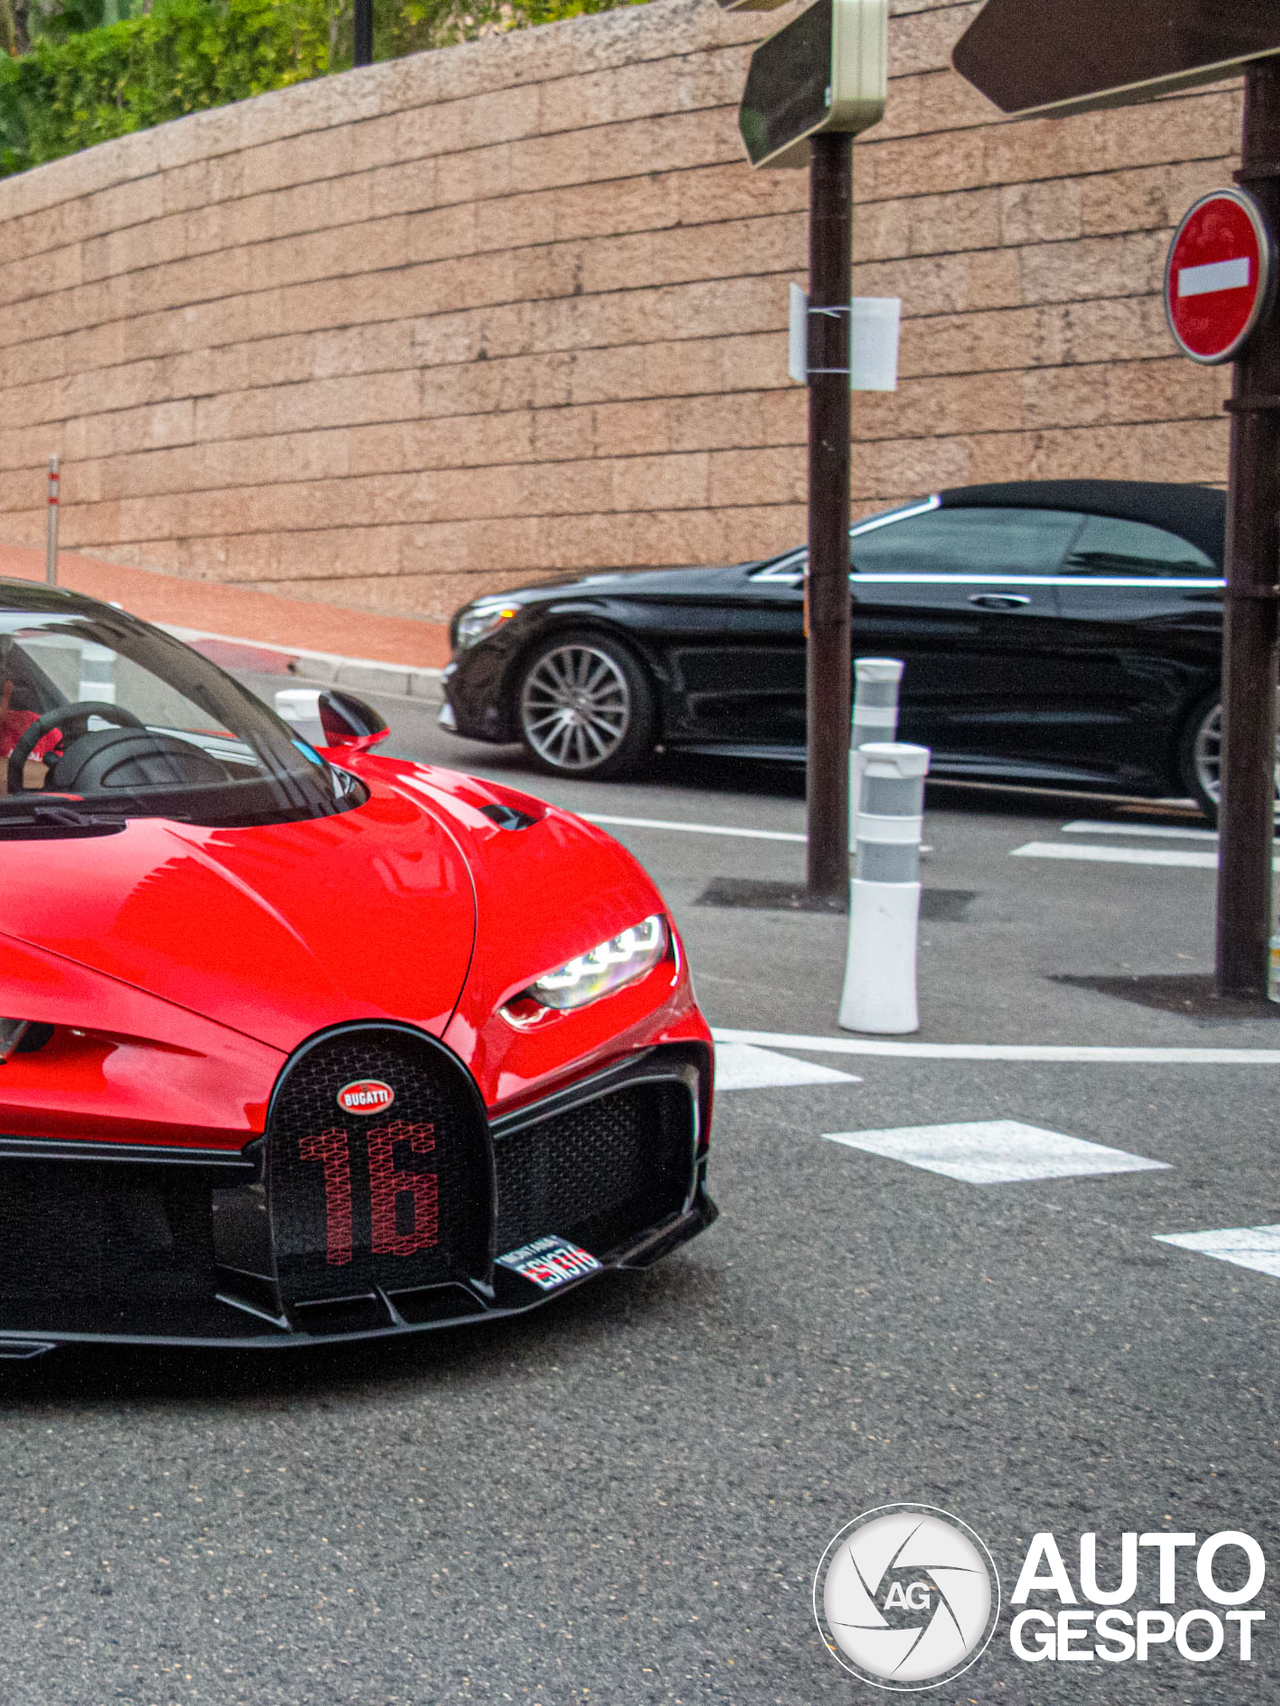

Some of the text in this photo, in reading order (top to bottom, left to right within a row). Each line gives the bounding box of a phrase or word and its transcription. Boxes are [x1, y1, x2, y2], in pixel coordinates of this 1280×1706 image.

[344, 1091, 388, 1107] BUGATTI
[299, 1121, 438, 1265] 16
[499, 1237, 556, 1263] MONTANA
